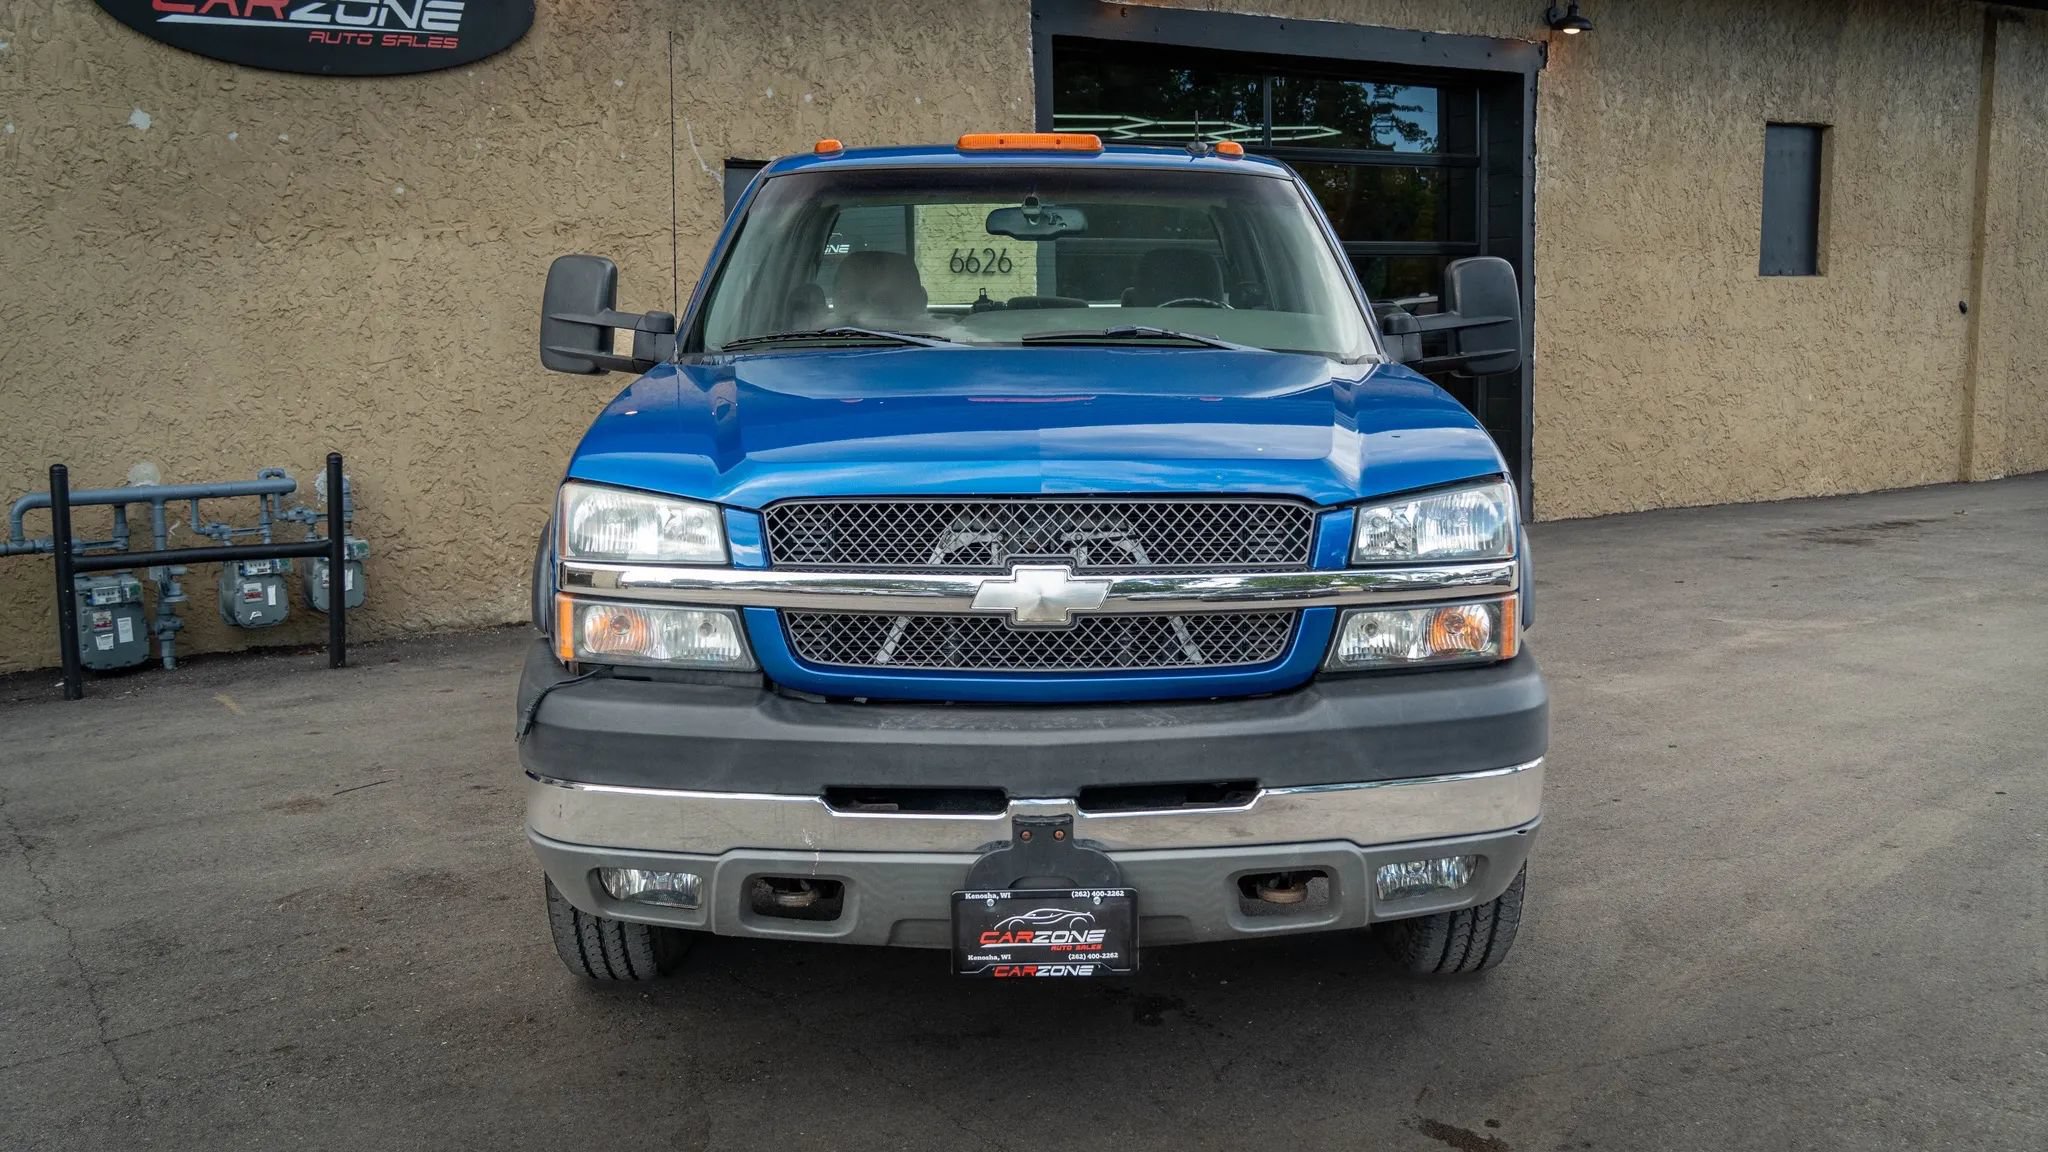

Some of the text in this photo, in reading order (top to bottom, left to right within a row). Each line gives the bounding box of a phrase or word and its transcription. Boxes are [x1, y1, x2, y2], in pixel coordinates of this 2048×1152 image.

[308, 31, 459, 49] AUTO SALES
[949, 247, 1013, 274] 6626
[980, 929, 1106, 944] CARZONE
[994, 965, 1094, 977] CARZONE
